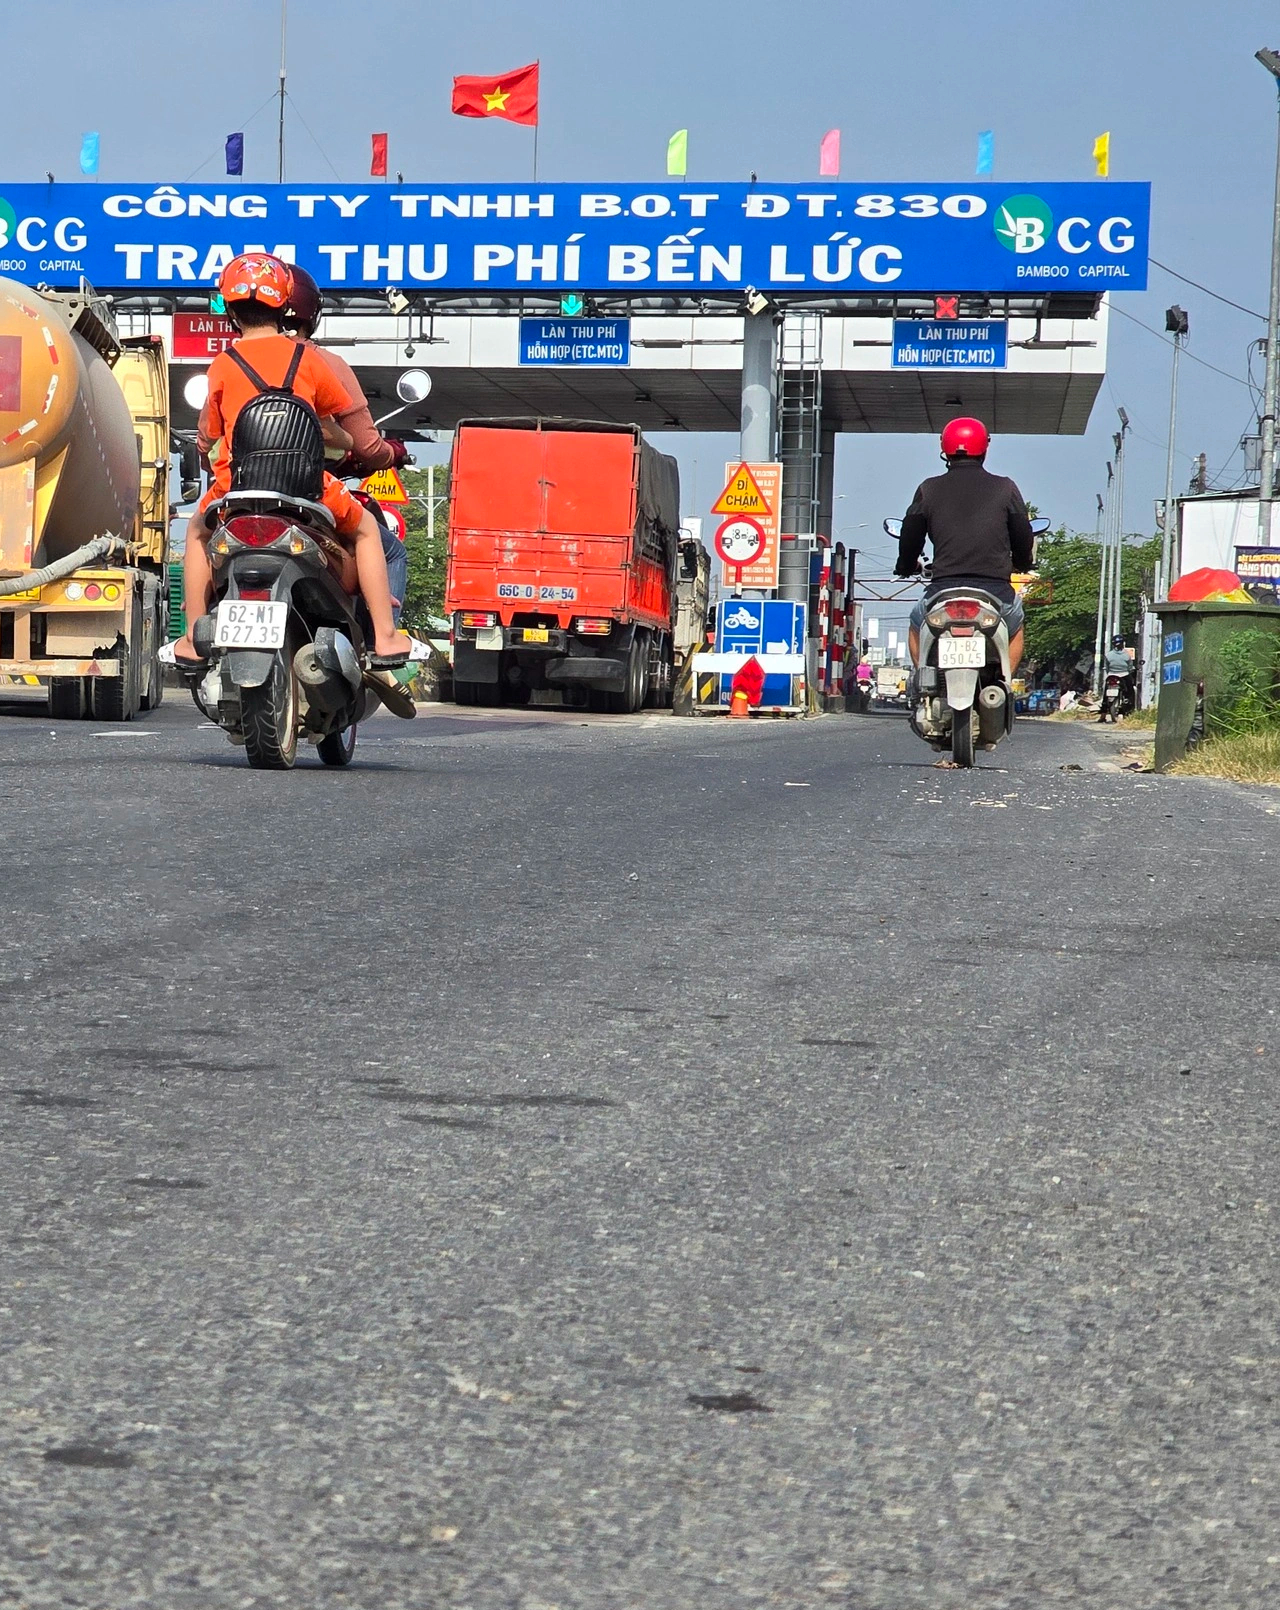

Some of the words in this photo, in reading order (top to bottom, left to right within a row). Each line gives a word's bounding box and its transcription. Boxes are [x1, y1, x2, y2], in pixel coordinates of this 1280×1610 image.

[103, 186, 267, 218] CÔNG
[287, 195, 370, 218] TY
[390, 194, 554, 218] TNHH
[580, 194, 719, 218] B.O.T
[1015, 217, 1134, 254] BCG
[319, 244, 448, 281] THU
[473, 233, 586, 281] PHÍ
[608, 228, 742, 282] BẾN
[770, 231, 903, 282] LỨC
[39, 260, 84, 271] CAPITAL
[1016, 266, 1069, 278] BAMBOO
[1078, 266, 1130, 278] CAPITAL
[190, 318, 212, 332] LÀN
[541, 323, 565, 338] LÀN
[571, 326, 594, 338] THU
[597, 323, 617, 338] PHÍ
[918, 325, 942, 340] LÀN
[945, 328, 967, 340] THU
[970, 325, 990, 340] PHÍ
[527, 341, 548, 359] HỖN
[898, 344, 919, 362] HỖN
[366, 481, 396, 497] CHẬM
[726, 492, 758, 508] CHẬM
[229, 606, 273, 623] 62-N1
[220, 625, 280, 643] 627.35
[943, 653, 981, 665] 950.45
